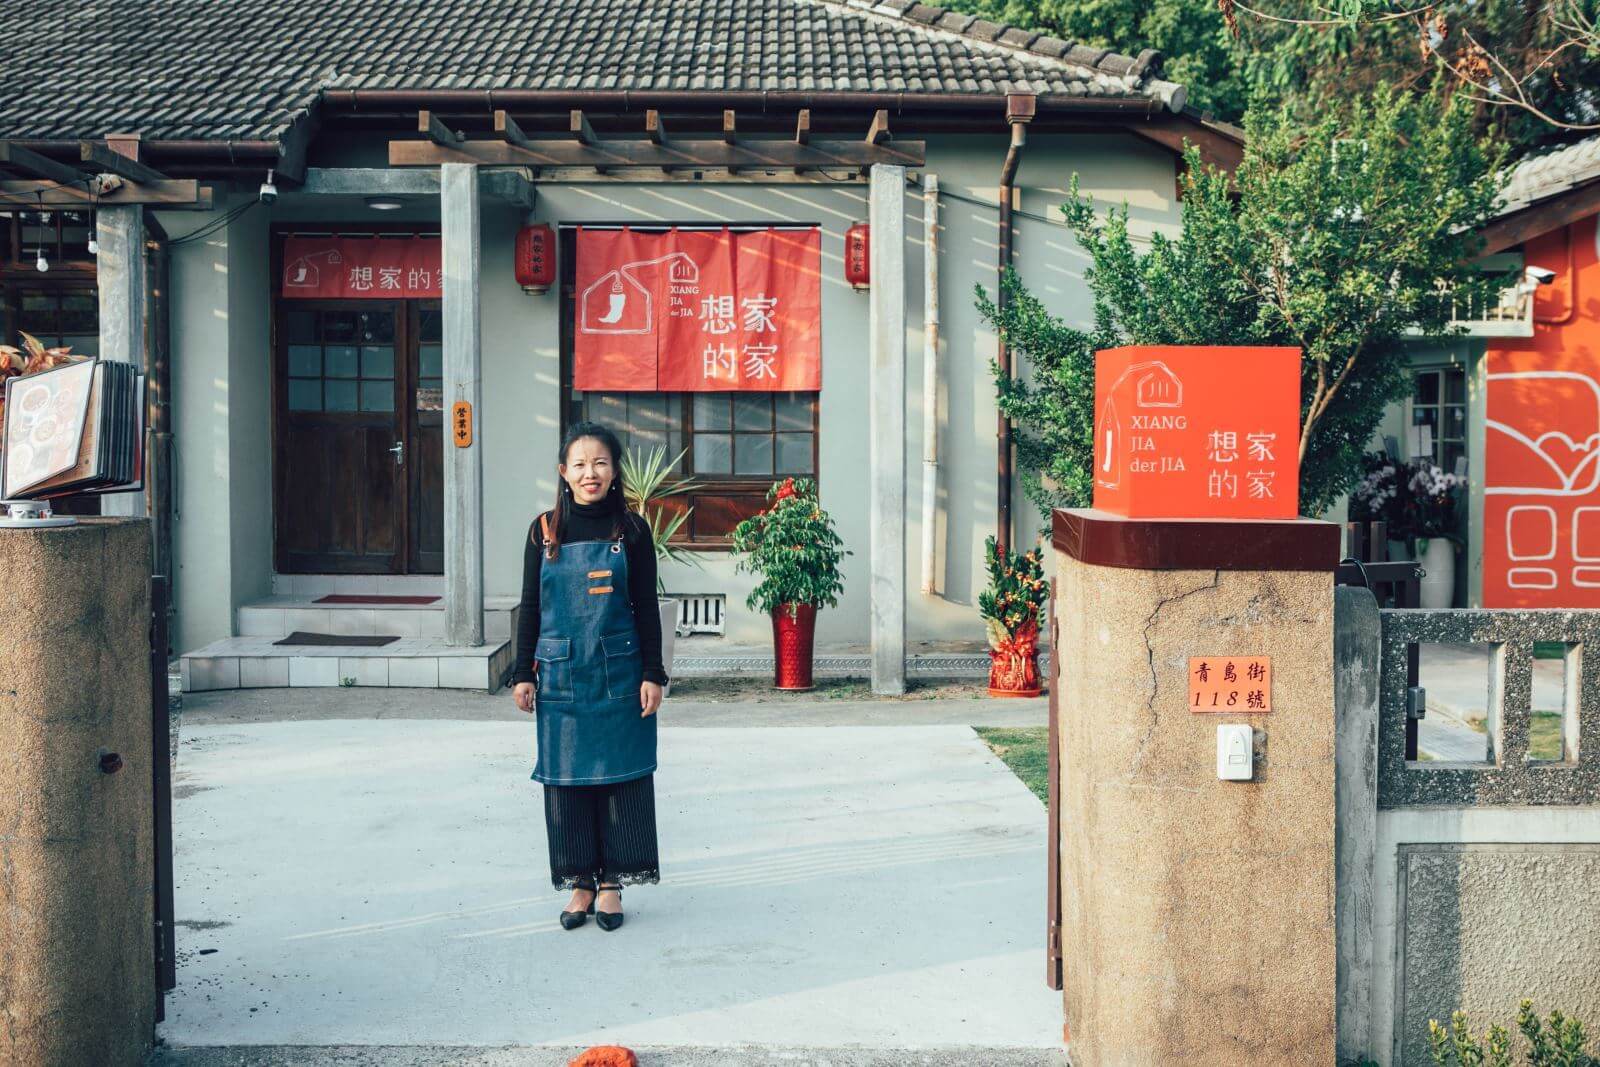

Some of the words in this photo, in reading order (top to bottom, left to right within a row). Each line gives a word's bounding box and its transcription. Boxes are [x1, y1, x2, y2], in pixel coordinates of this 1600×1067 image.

[349, 266, 442, 290] 想家的
[670, 285, 699, 294] XIANG
[670, 296, 683, 306] JIA
[680, 307, 693, 317] JIA
[698, 292, 778, 334] 想家
[703, 342, 778, 379] 的家
[1131, 415, 1187, 430] XIANG
[1130, 437, 1156, 453] JIA
[1208, 430, 1276, 463] 想家
[1130, 459, 1157, 473] der
[1160, 457, 1186, 473] JIA
[1208, 469, 1276, 499] 的家
[1195, 661, 1267, 683] 青島街
